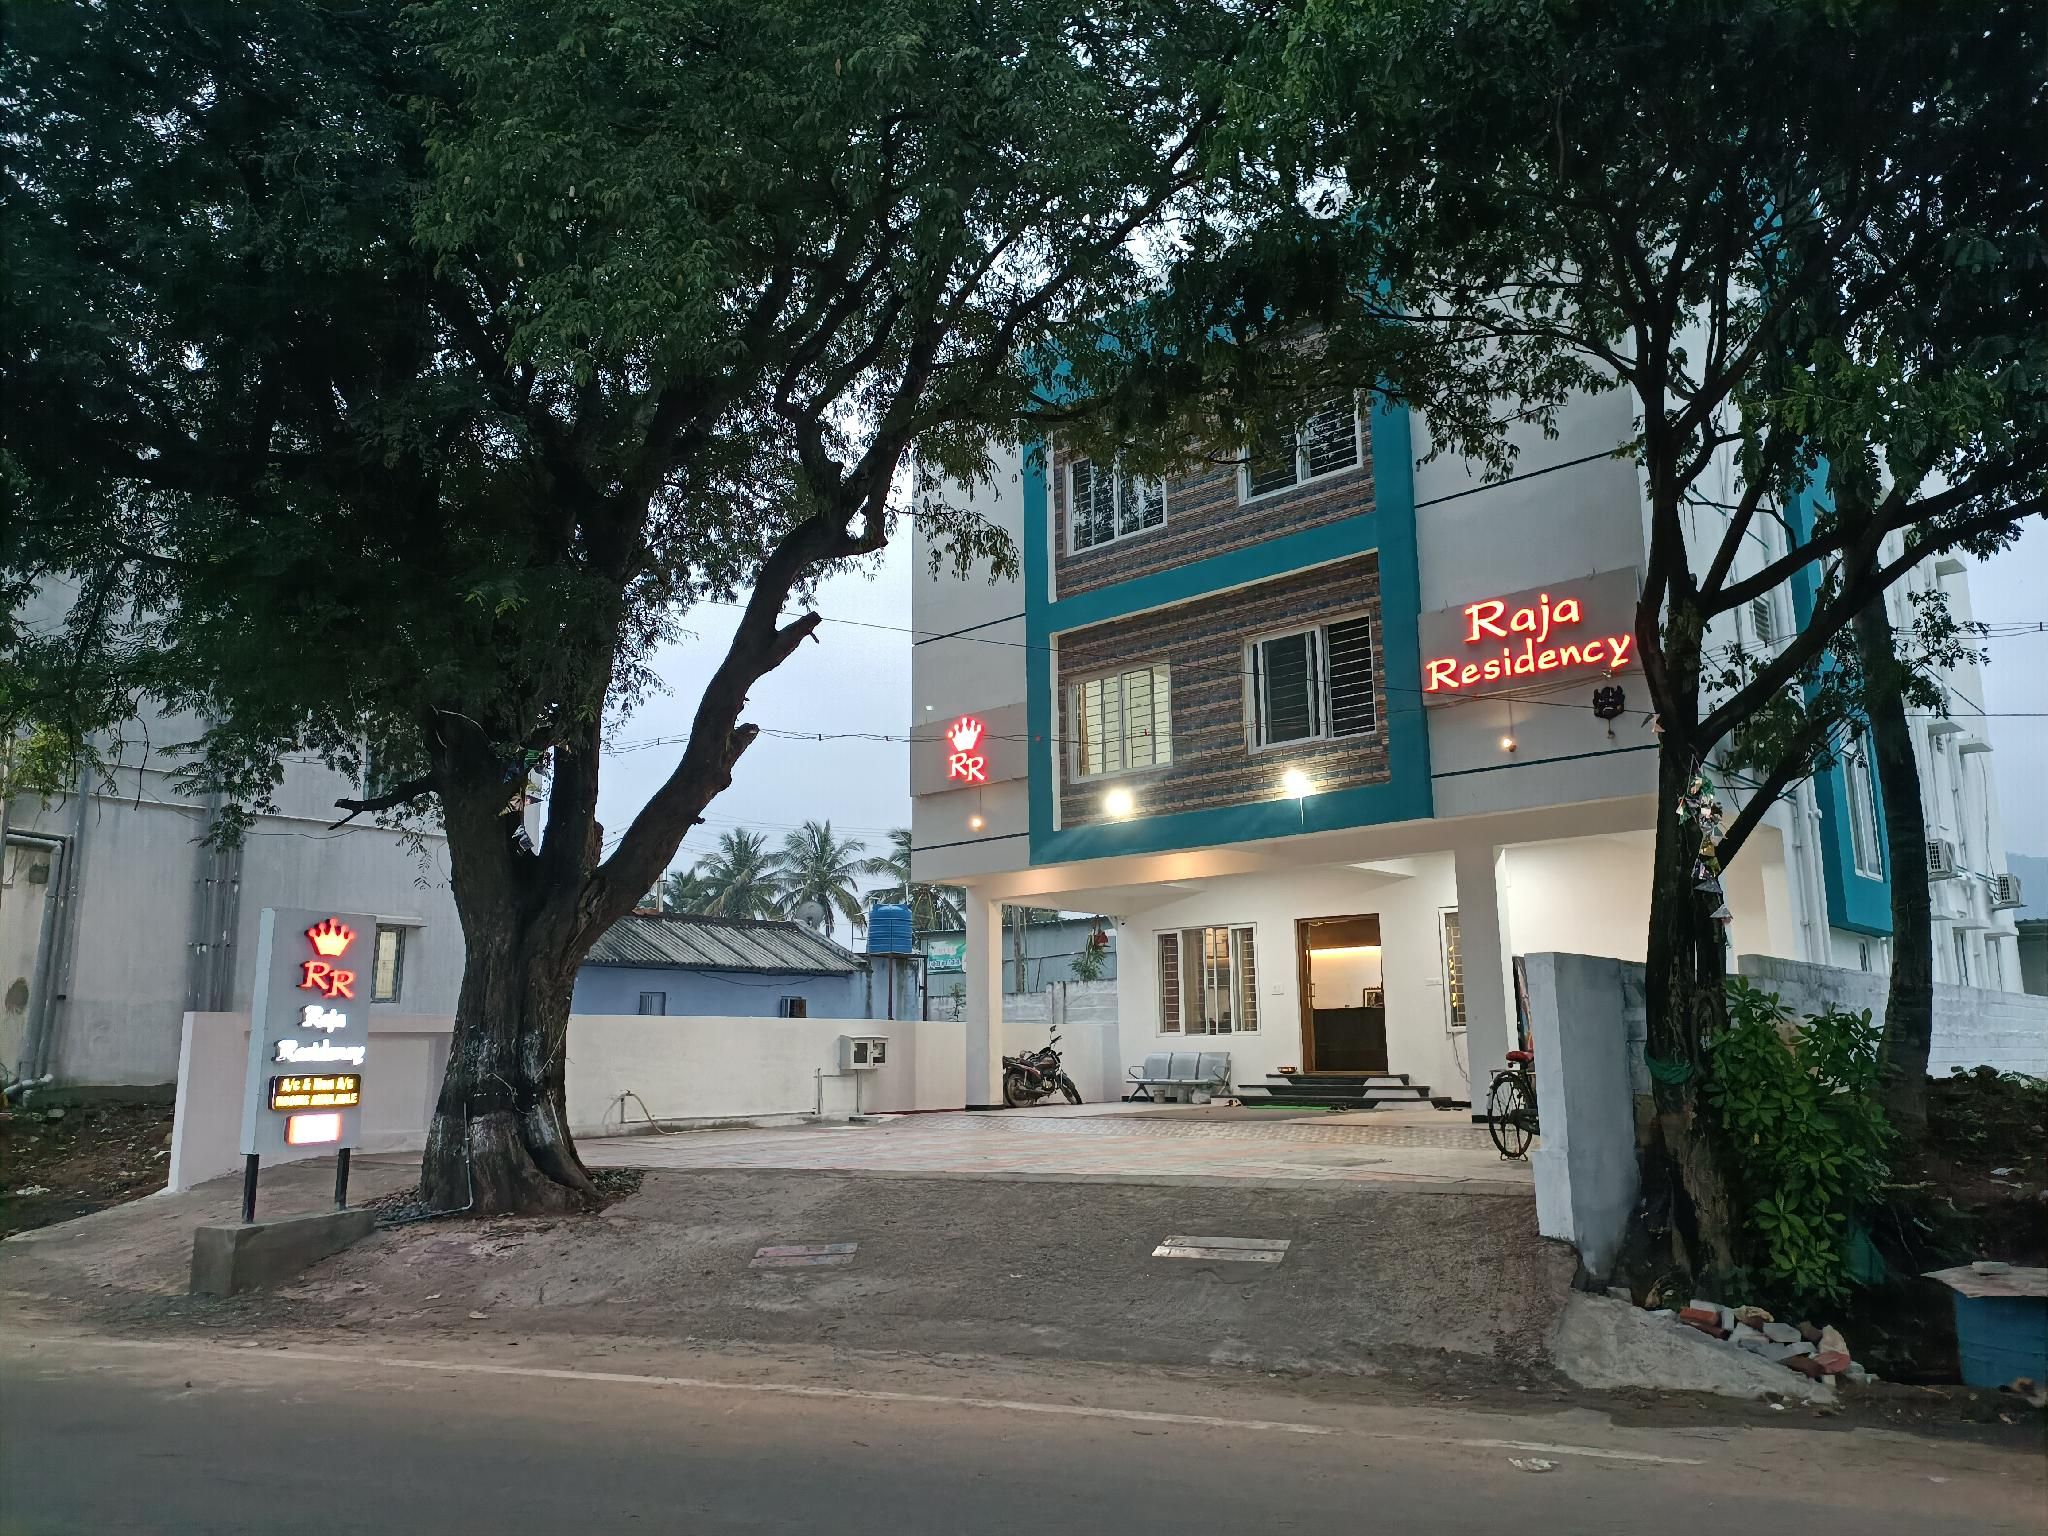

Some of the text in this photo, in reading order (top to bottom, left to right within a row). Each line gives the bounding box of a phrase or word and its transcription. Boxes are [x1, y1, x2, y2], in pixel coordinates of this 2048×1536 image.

[1463, 593, 1581, 643] Raja
[1423, 634, 1631, 692] Residency
[948, 752, 985, 781] RR
[296, 960, 357, 999] RR
